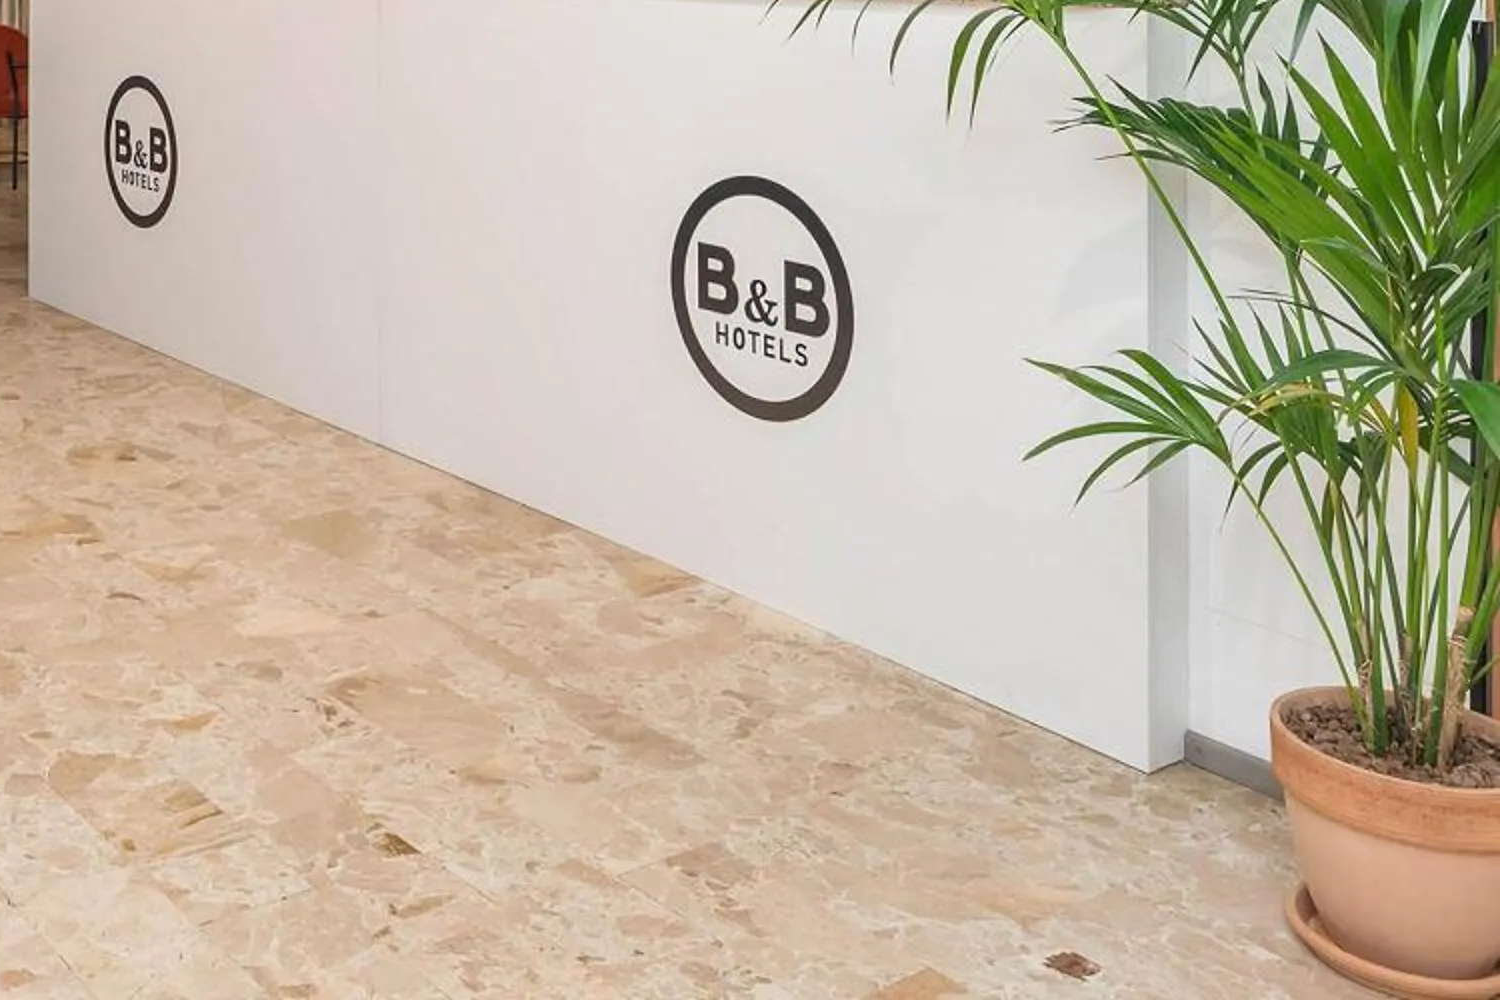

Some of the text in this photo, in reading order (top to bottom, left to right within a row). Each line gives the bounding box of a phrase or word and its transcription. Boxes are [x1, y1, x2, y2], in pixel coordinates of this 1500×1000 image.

[114, 119, 169, 174] B&B
[121, 169, 160, 193] HOTELS
[697, 241, 831, 338] B&B
[715, 321, 808, 367] HOTELS
